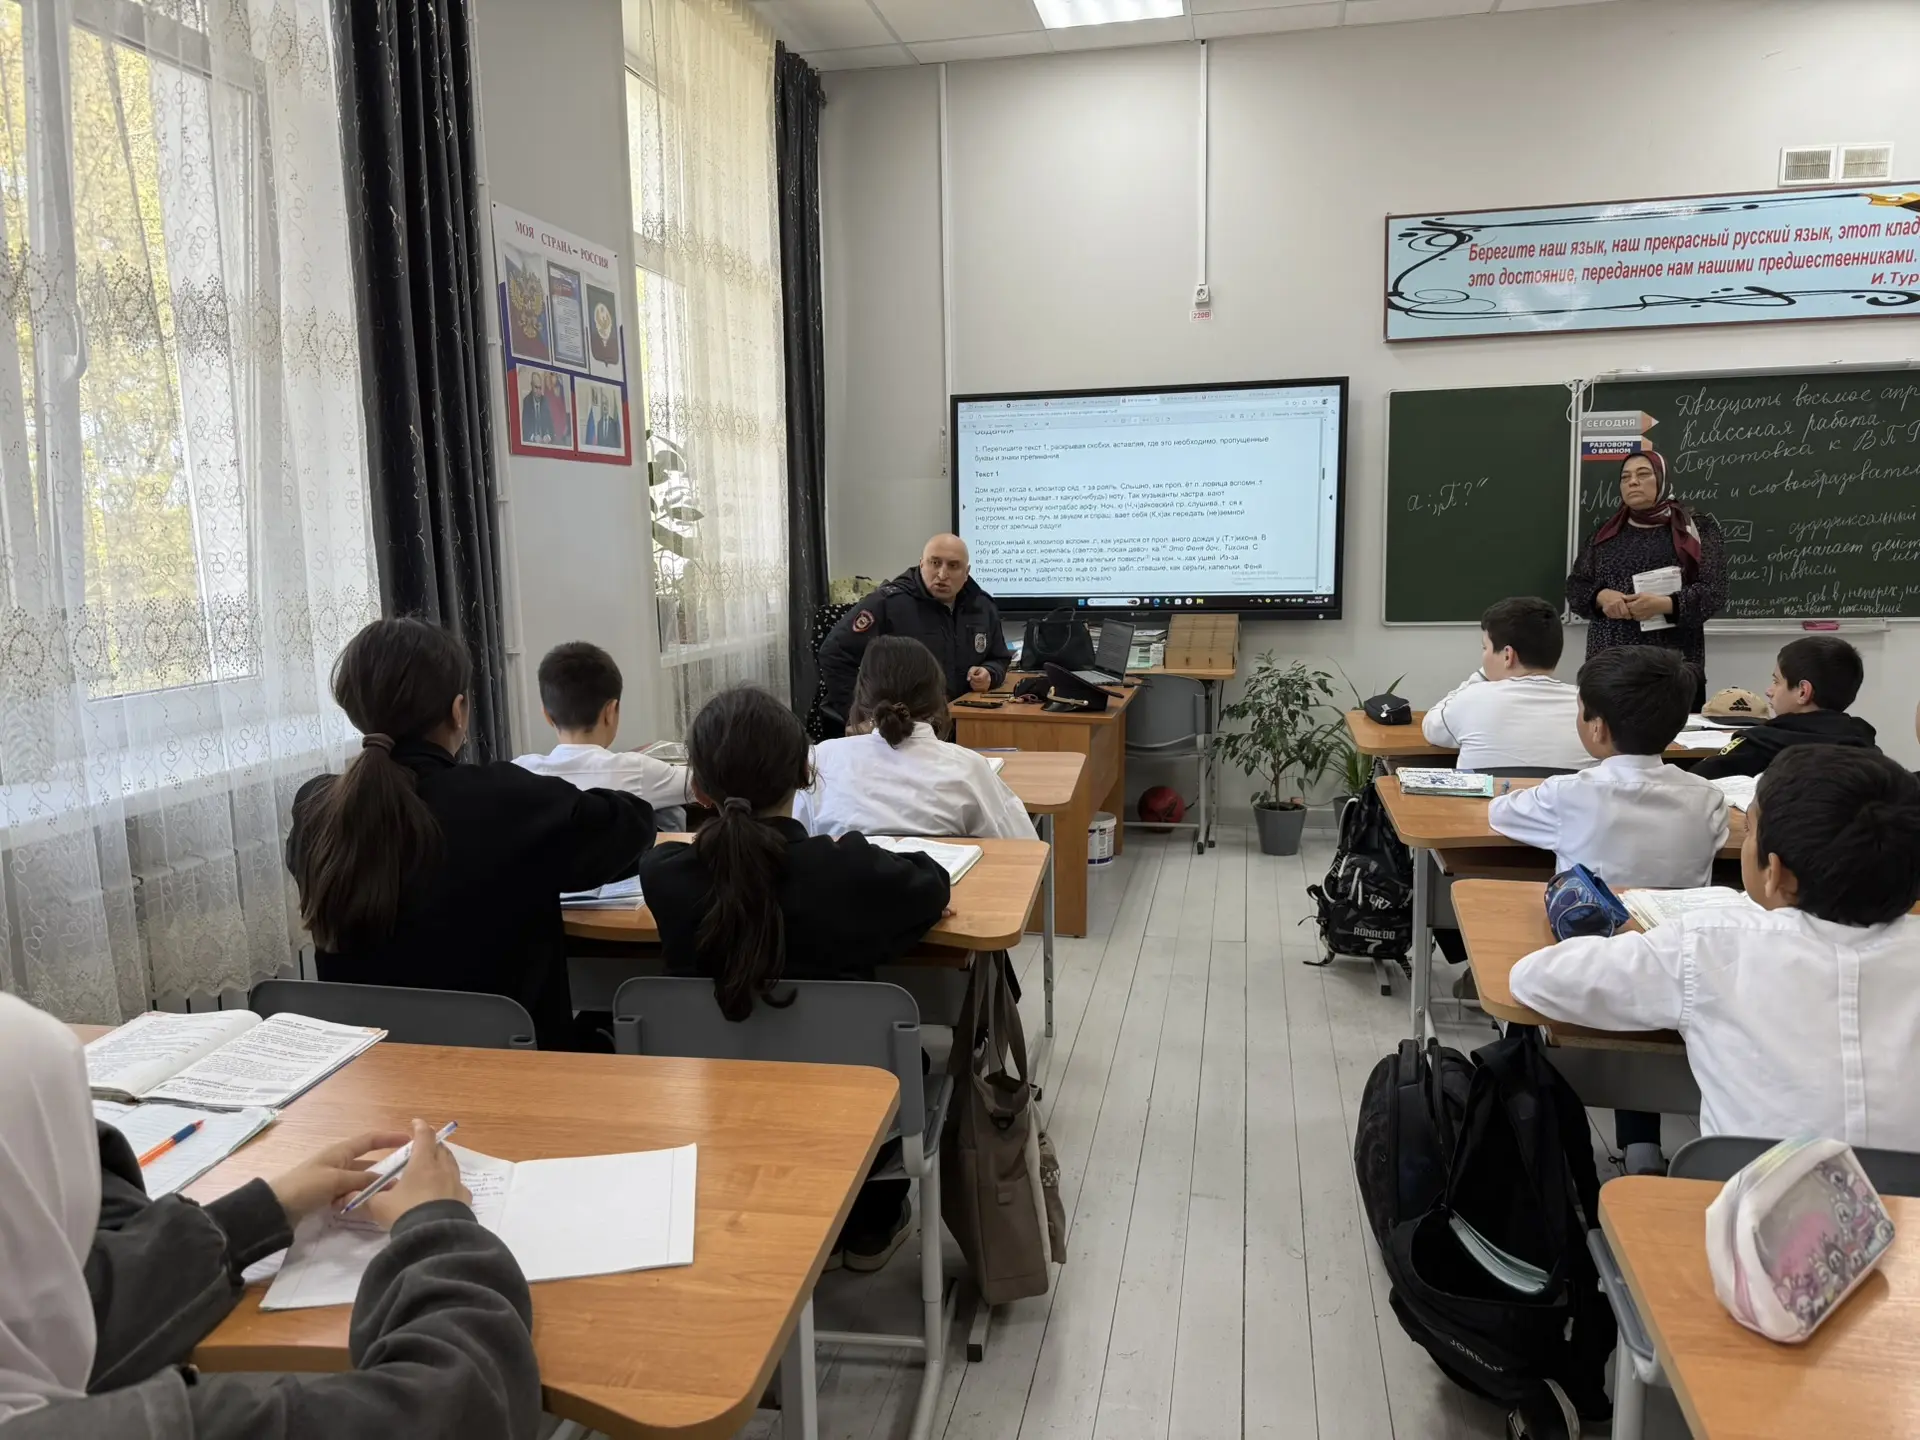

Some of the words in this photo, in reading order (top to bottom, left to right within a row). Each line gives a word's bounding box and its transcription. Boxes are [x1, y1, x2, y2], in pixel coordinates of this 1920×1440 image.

[515, 220, 534, 240] МОЯ
[580, 248, 608, 269] РОССИЯ
[1468, 242, 1535, 264] Берегите
[1538, 242, 1567, 257] наш
[1570, 239, 1607, 257] язык,
[1611, 237, 1640, 253] наш
[1644, 228, 1729, 258] прекрасный
[1732, 224, 1791, 250] русский
[1794, 226, 1833, 244] язык,
[1838, 222, 1881, 239] этот
[1468, 271, 1494, 288] это
[1498, 267, 1577, 285] достояние,
[1581, 261, 1662, 284] переданное
[1666, 260, 1693, 276] нам
[1697, 258, 1754, 275] нашими
[1757, 249, 1917, 275] предшественниками.
[1676, 386, 1782, 430] Двадцать
[1792, 382, 1873, 407] восьмое
[1586, 418, 1636, 428] СЕГОДНЯ
[1220, 436, 1269, 447] пропущенные
[1680, 420, 1795, 451] Классная
[1673, 440, 1815, 481] Подготовка
[1828, 440, 1841, 451] к
[974, 486, 988, 494] Дом
[1730, 488, 1739, 498] и
[1261, 534, 1267, 542] В
[1220, 554, 1239, 562] Из-за
[1767, 542, 1864, 570] обозначает
[1244, 562, 1263, 570] Феня
[1354, 926, 1396, 940] RONALDO
[1365, 938, 1382, 954] 7
[1450, 1339, 1504, 1372] JORDAN
